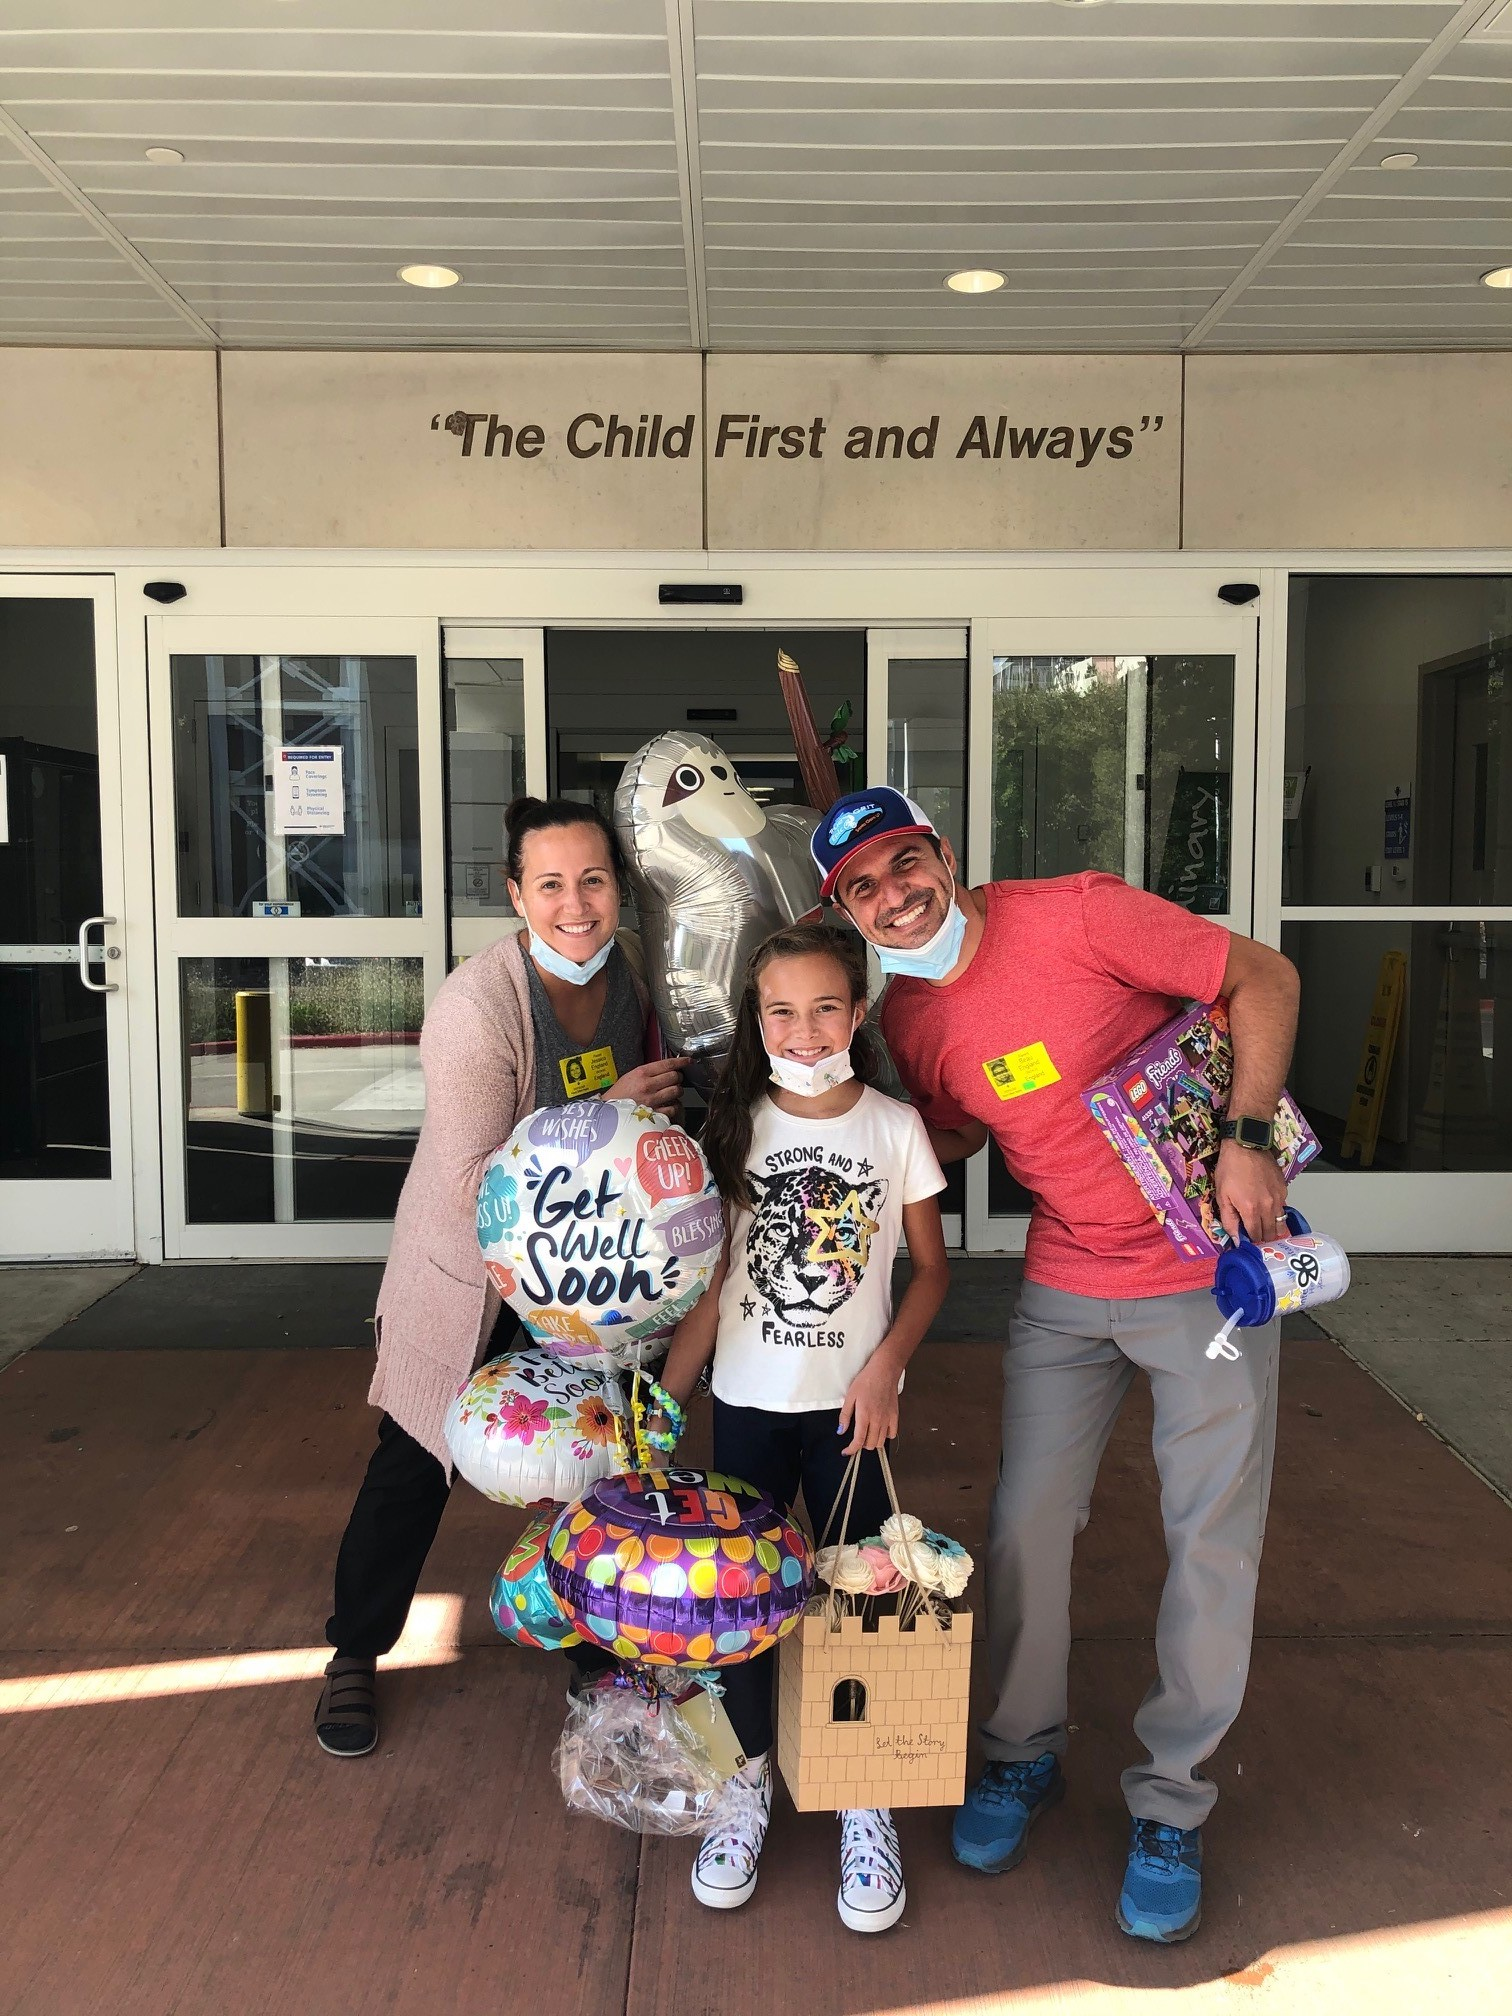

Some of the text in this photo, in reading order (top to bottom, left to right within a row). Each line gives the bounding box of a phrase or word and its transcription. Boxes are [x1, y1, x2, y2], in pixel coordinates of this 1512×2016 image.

[566, 413, 695, 459] Child
[714, 415, 827, 459] First
[847, 415, 940, 459] and
[1130, 1047, 1182, 1102] LEGO Friends
[542, 1118, 598, 1143] WISHES
[643, 1136, 696, 1162] CHEER
[765, 1146, 853, 1173] STRONG AND
[657, 1162, 692, 1190] UP!
[533, 1165, 623, 1229] Get
[477, 1197, 513, 1229] SS U!
[560, 1218, 650, 1262] Well
[671, 1210, 723, 1248] BLESSING
[521, 1231, 664, 1306] Soon
[762, 1321, 845, 1348] FEARLESS
[876, 1733, 946, 1751] Let the Story
[893, 1749, 928, 1764] Begin
